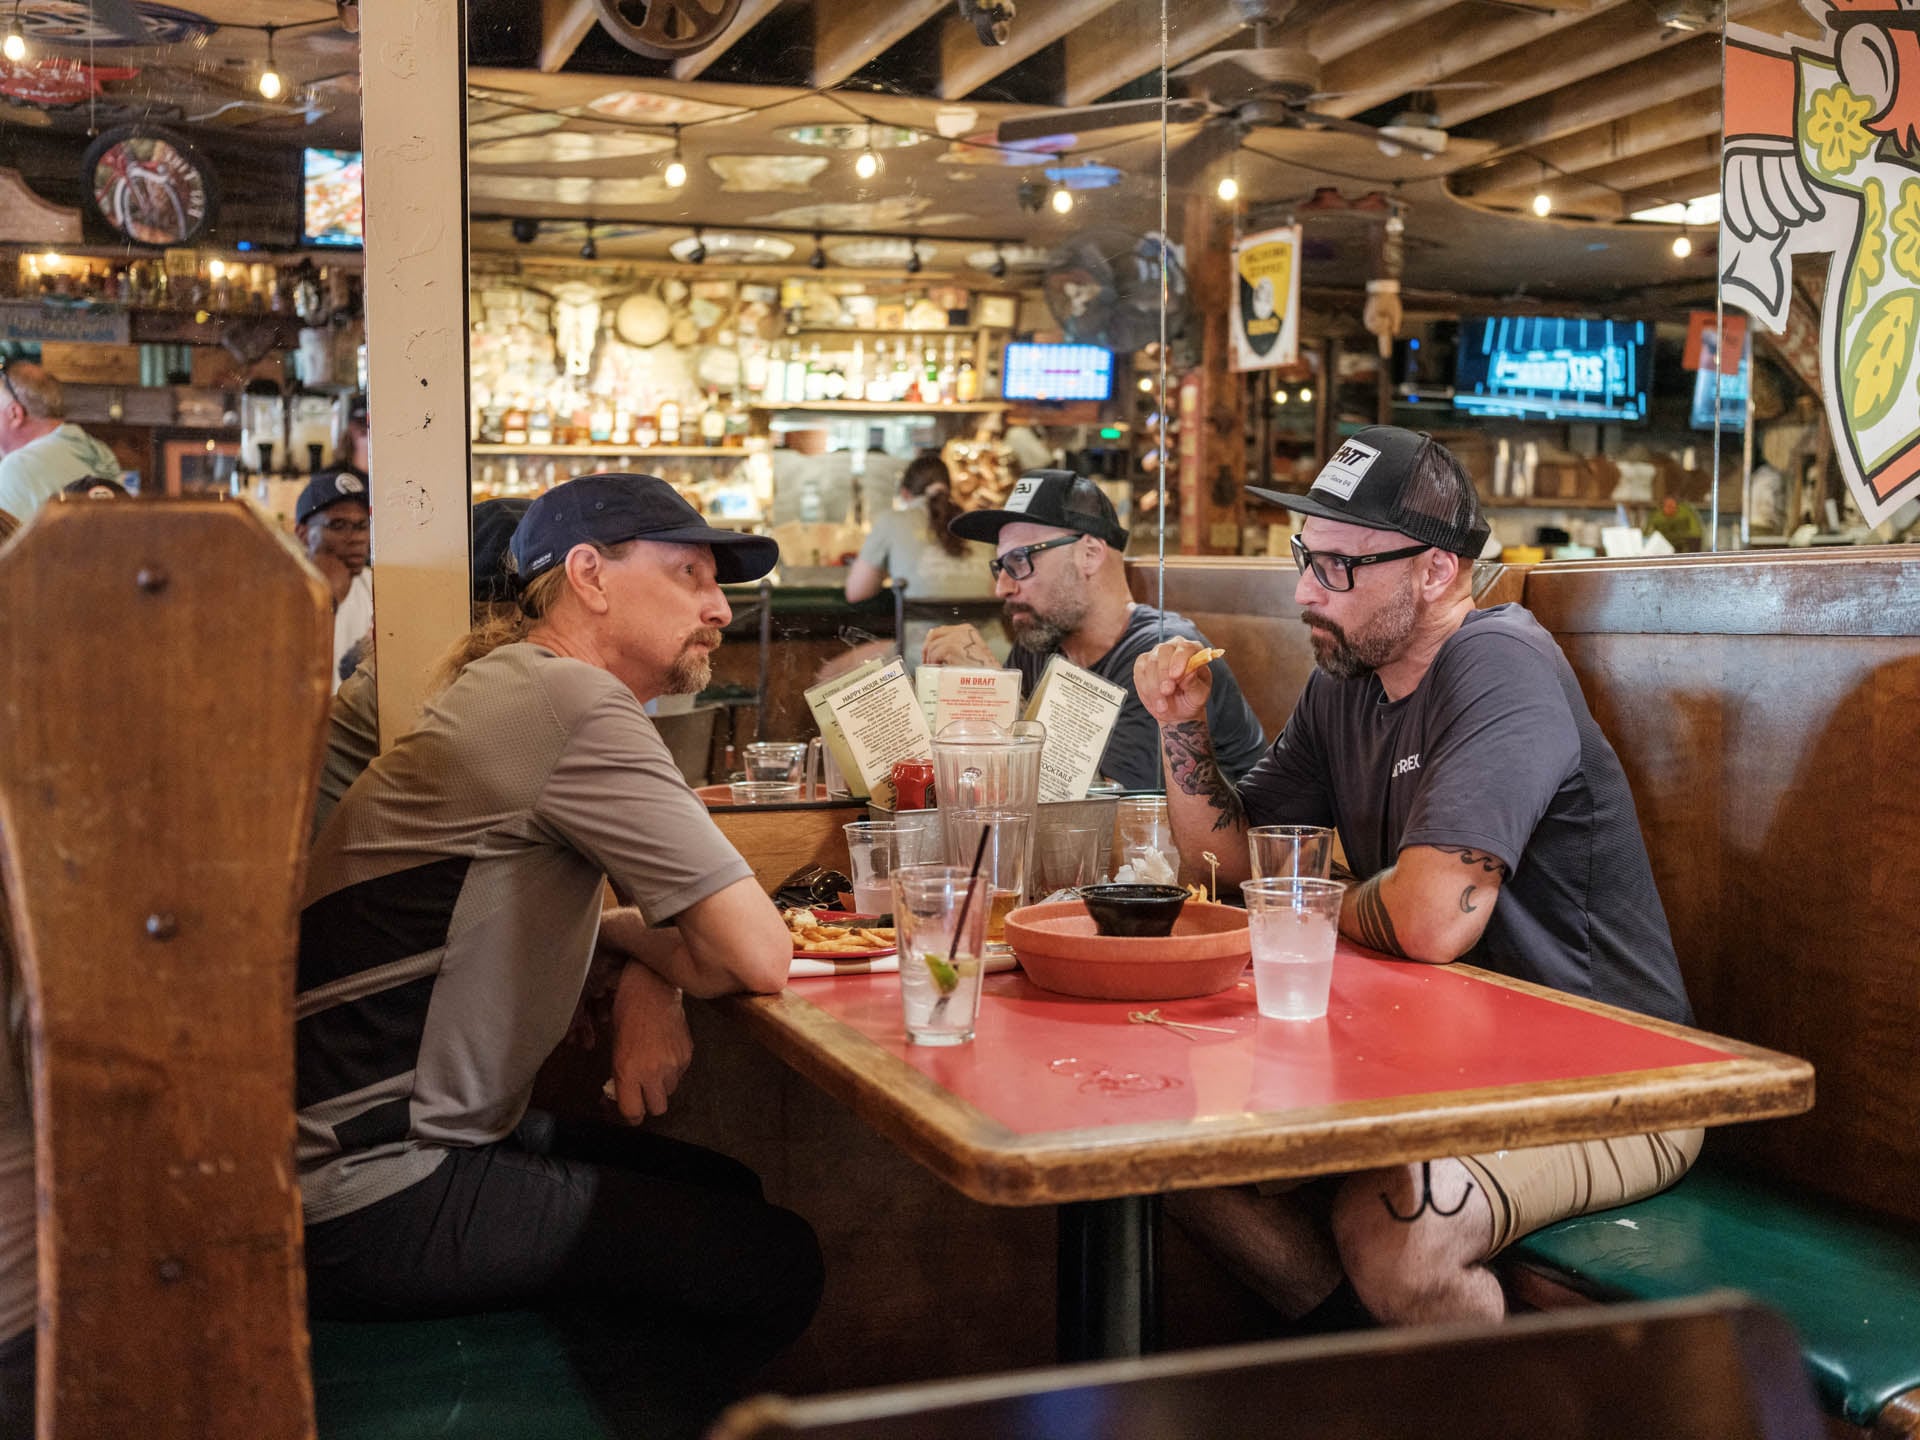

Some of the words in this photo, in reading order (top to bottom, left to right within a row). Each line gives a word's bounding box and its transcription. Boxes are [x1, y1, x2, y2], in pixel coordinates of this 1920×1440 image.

[842, 689, 861, 703] HAPPY
[861, 680, 879, 693] HOUR
[880, 670, 897, 682] MENU
[960, 677, 971, 685] ON
[972, 677, 996, 686] DRAFT
[1065, 671, 1083, 684] HAPPY
[1083, 680, 1099, 692] HOUR
[1099, 688, 1116, 701] MENU
